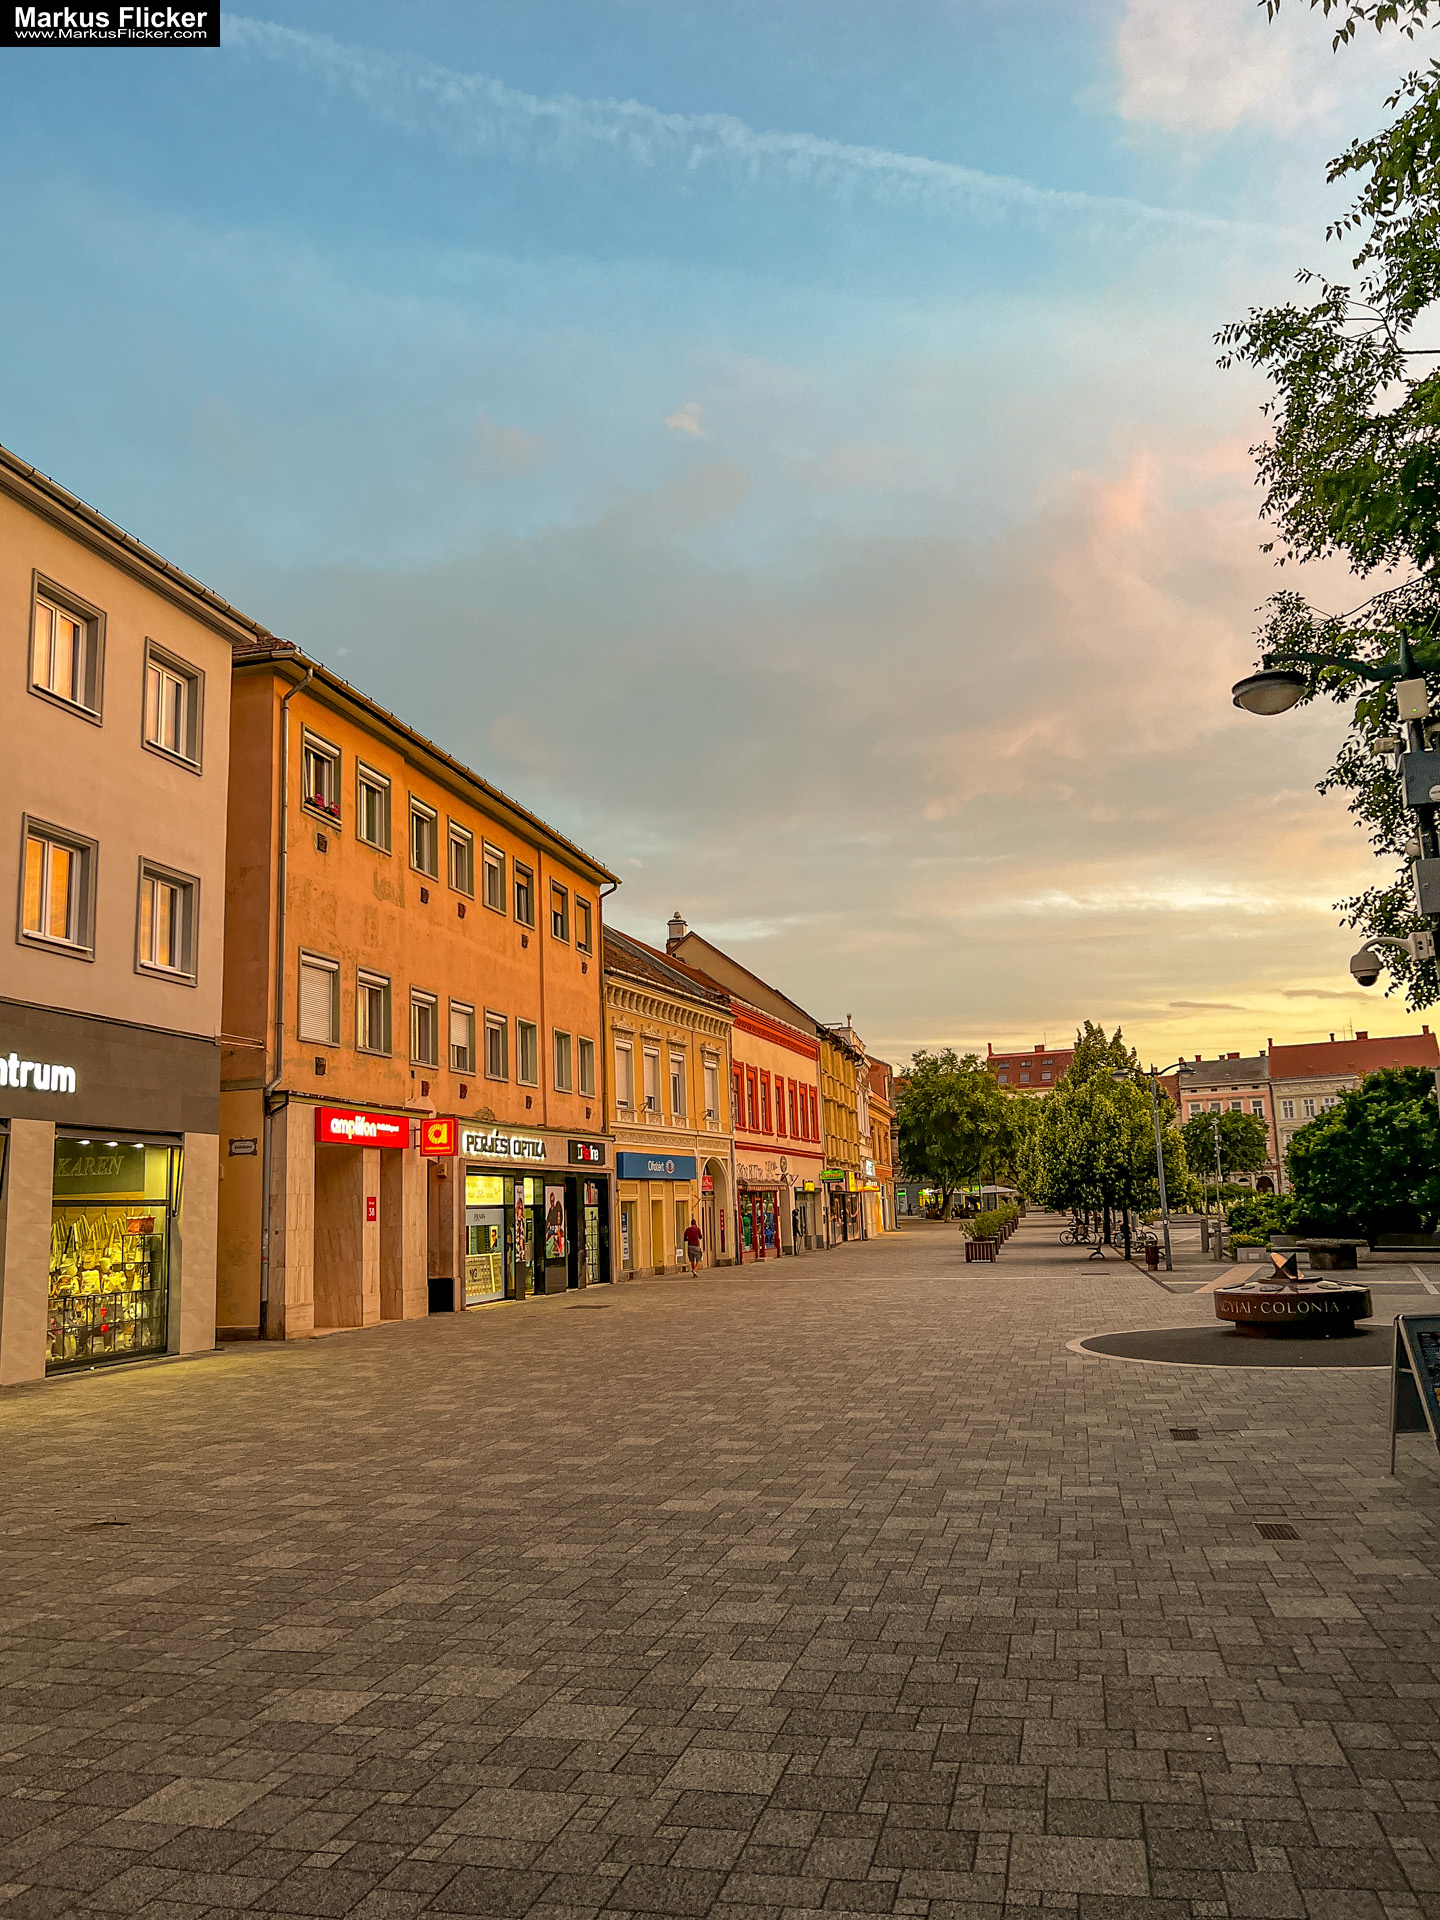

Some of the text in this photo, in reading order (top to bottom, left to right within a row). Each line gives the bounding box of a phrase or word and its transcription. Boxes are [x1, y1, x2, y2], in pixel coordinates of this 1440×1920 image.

[330, 1115, 377, 1140] amplifon
[513, 1139, 547, 1159] OPTIKA
[54, 1155, 125, 1177] KAREN
[1260, 1301, 1340, 1314] COLONIA
